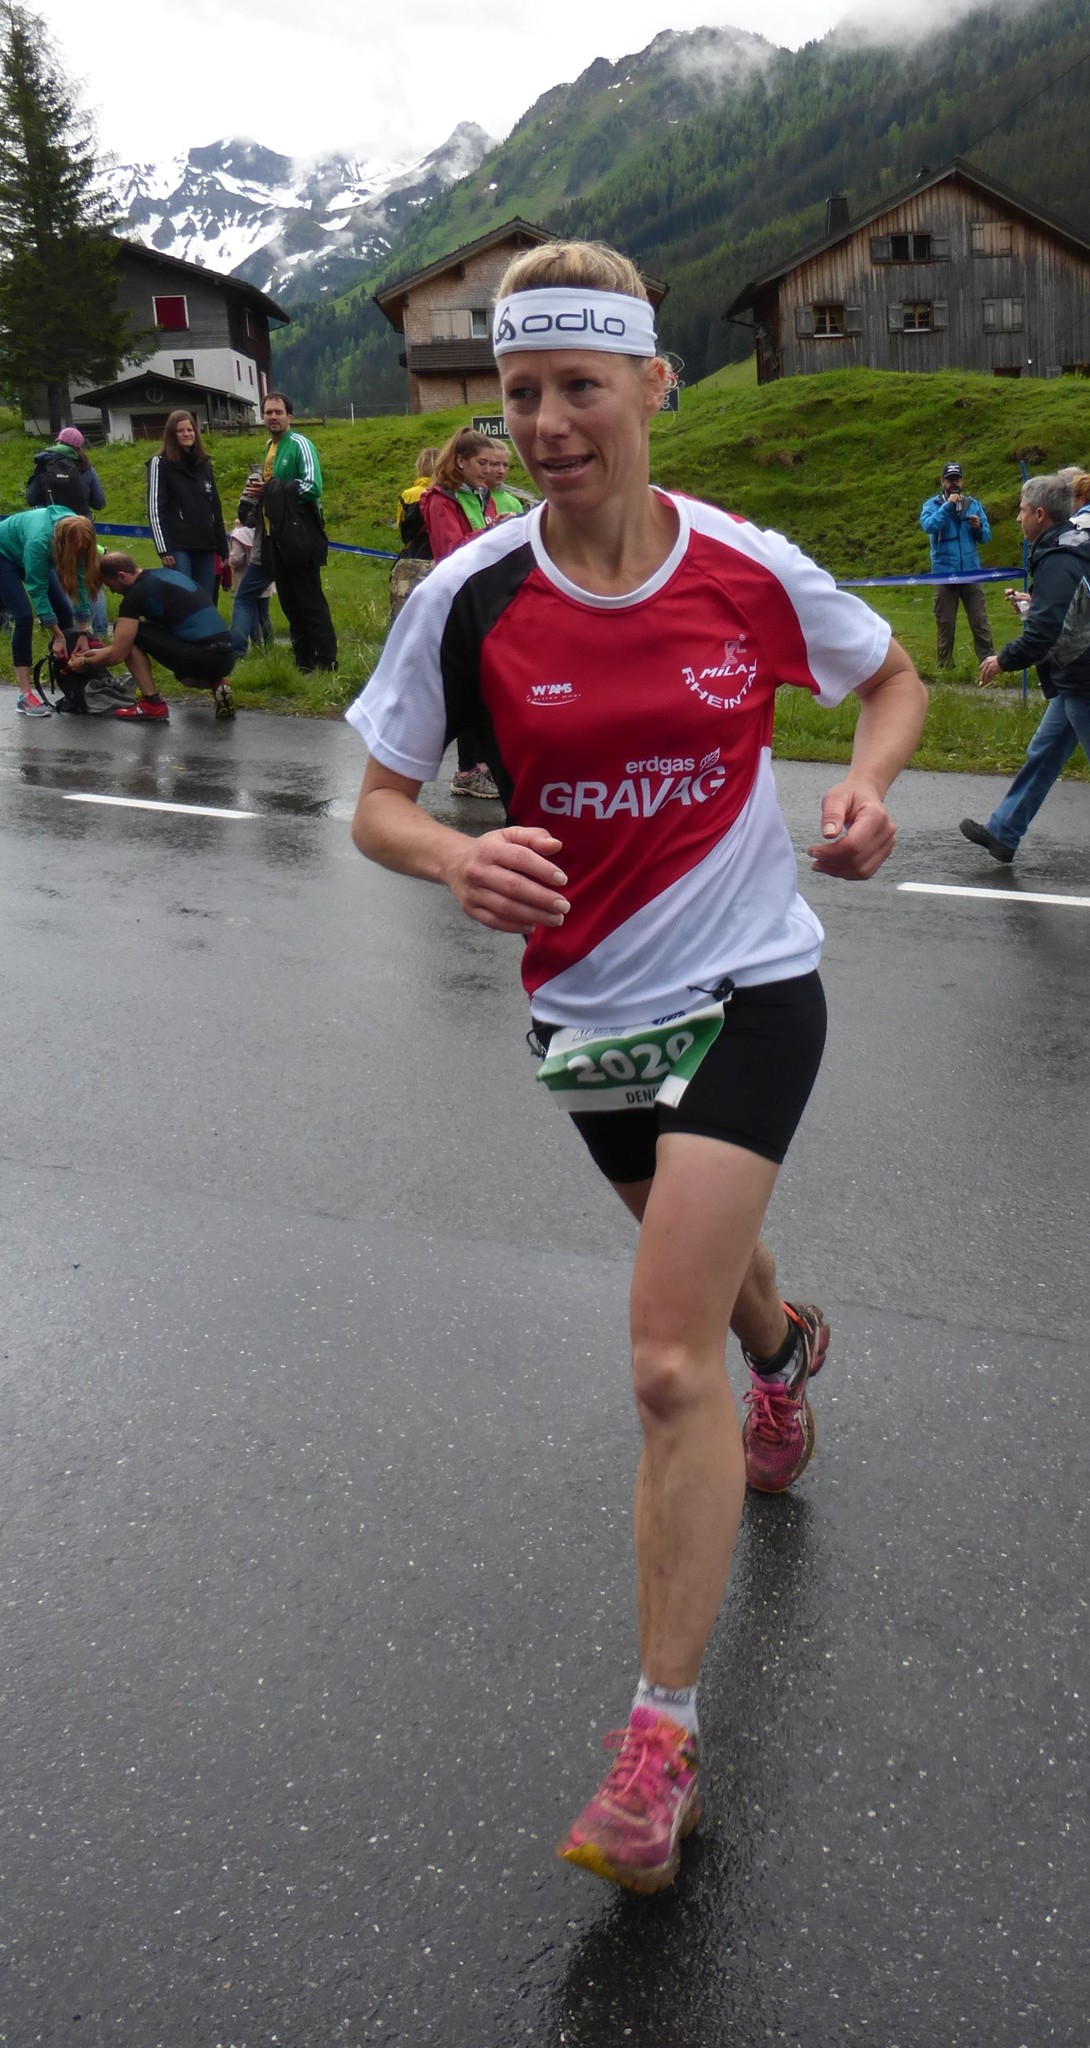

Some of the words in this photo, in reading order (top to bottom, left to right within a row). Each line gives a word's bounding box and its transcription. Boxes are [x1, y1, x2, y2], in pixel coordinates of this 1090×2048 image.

[521, 308, 626, 337] odlo
[682, 658, 757, 709] RHEINTAL
[625, 756, 695, 775] erdgas
[539, 765, 726, 820] GRAVAG
